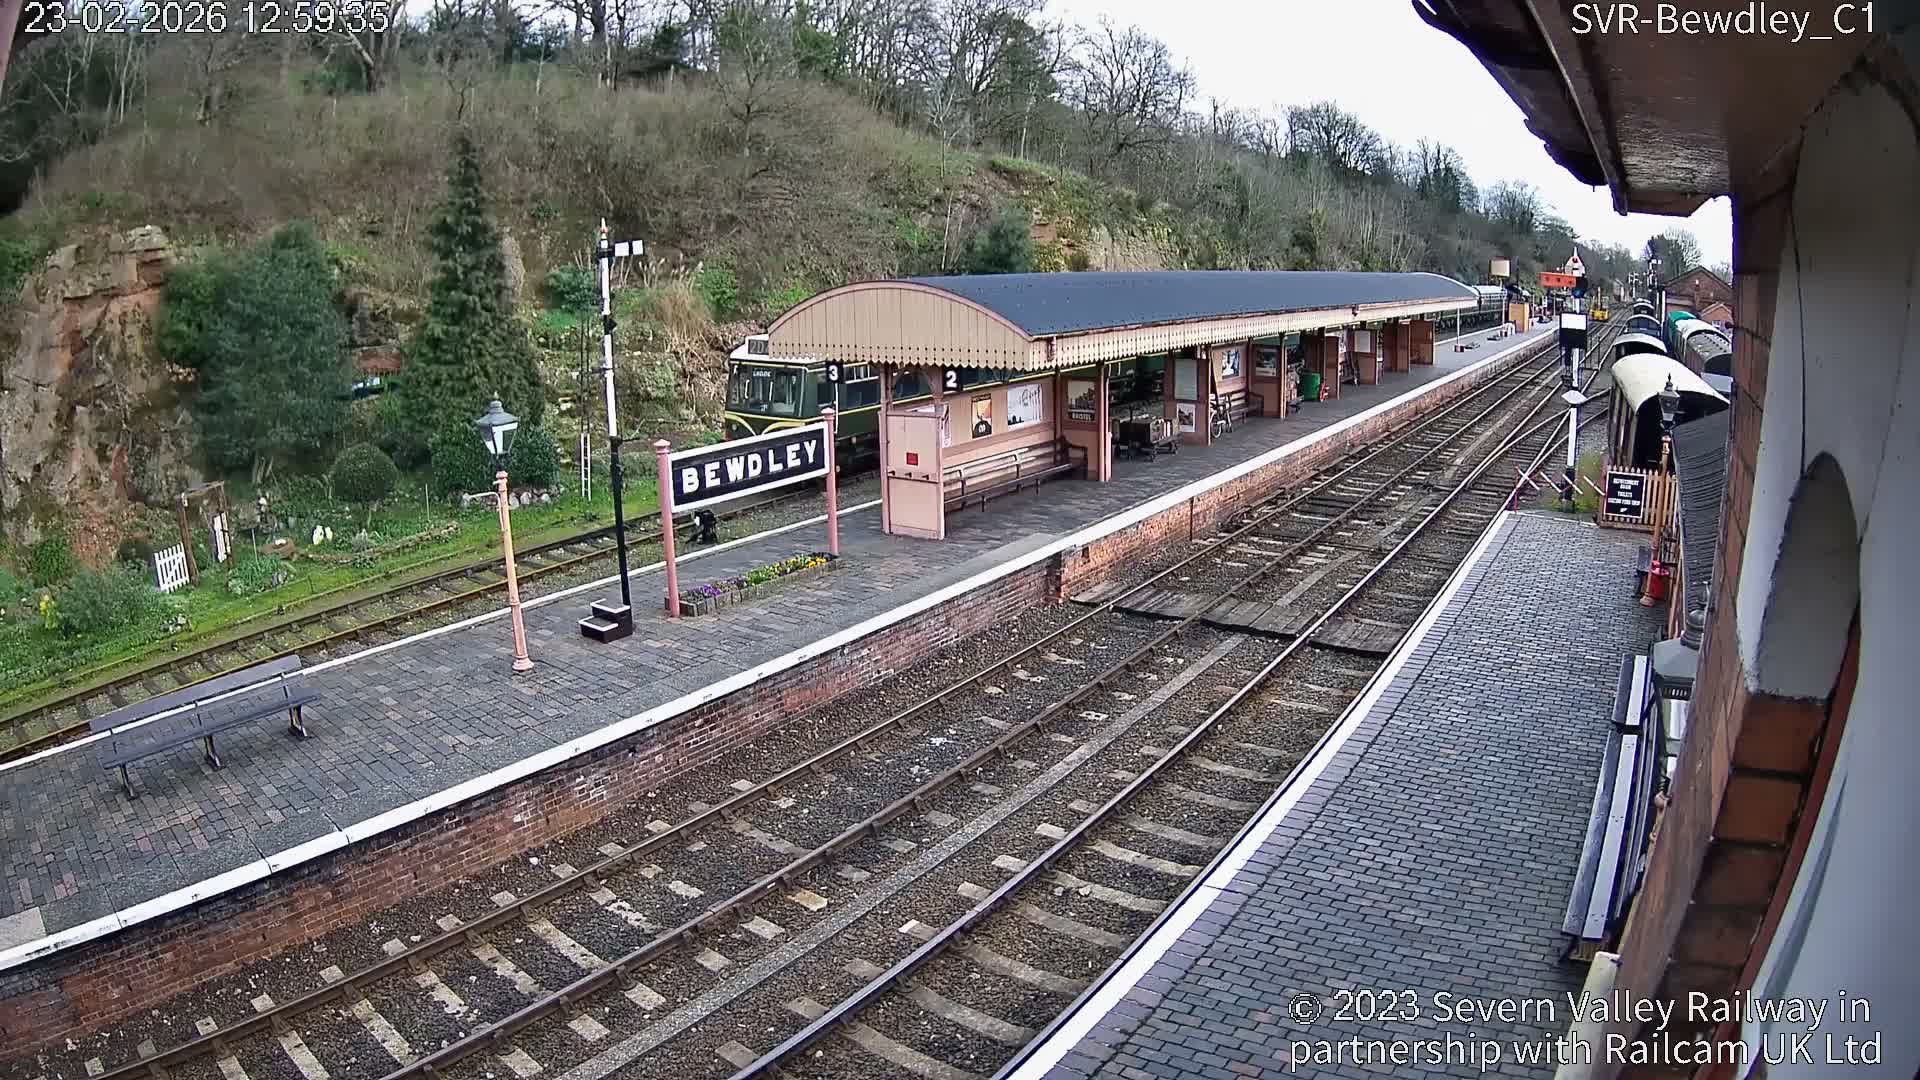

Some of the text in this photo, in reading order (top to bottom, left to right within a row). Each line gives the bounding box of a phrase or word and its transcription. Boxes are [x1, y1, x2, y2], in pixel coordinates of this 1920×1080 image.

[828, 365, 839, 381] 3
[946, 370, 957, 388] 2
[681, 439, 818, 494] BEWDLEY
